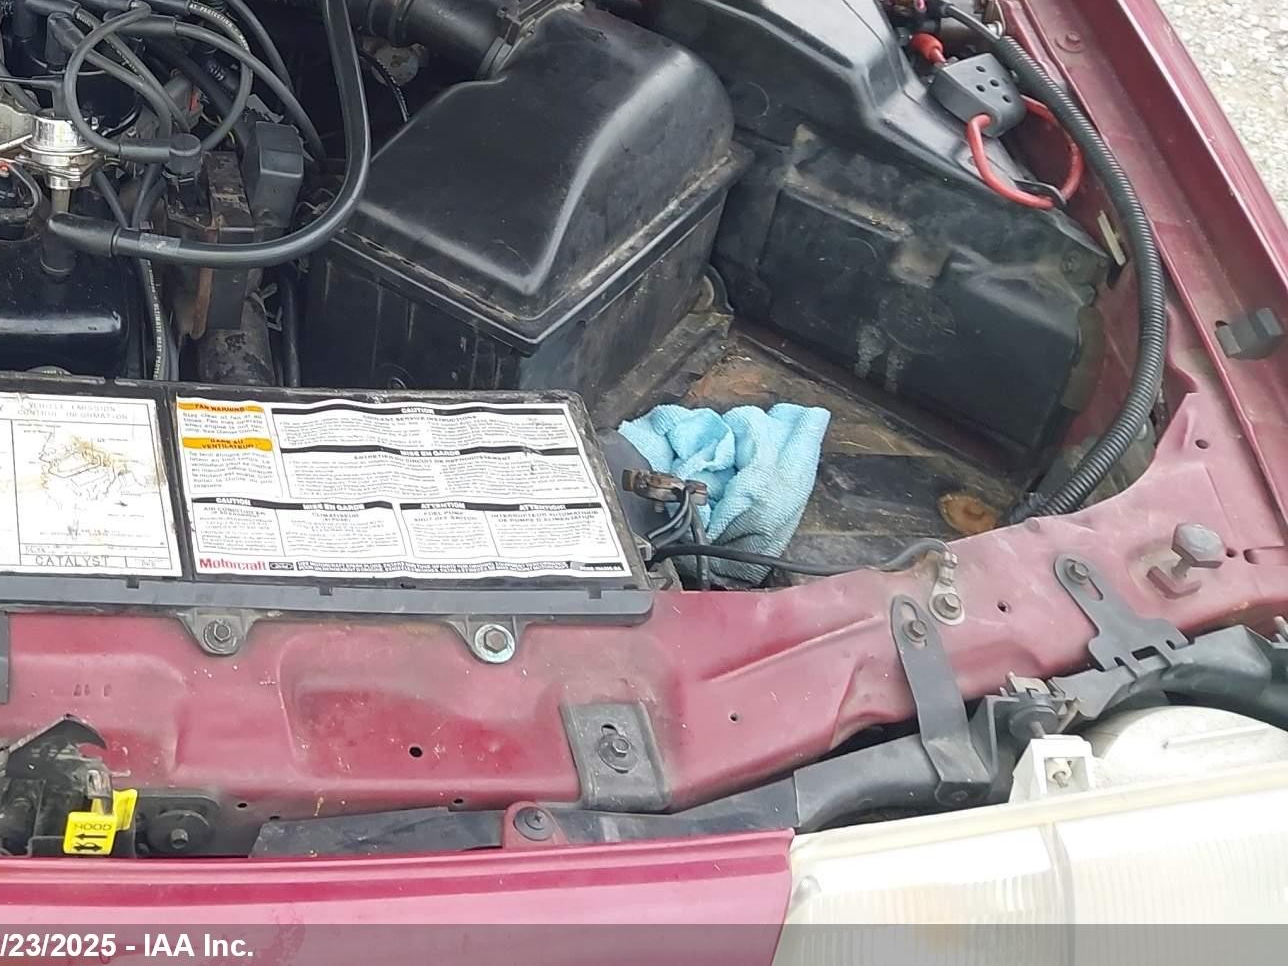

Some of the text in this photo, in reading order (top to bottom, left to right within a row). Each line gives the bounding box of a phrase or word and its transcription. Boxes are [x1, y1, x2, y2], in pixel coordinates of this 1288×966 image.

[215, 497, 251, 506] CAUTION
[35, 554, 109, 567] CATALYST
[199, 558, 267, 571] Motorcraft
[74, 823, 113, 831] HOOD
